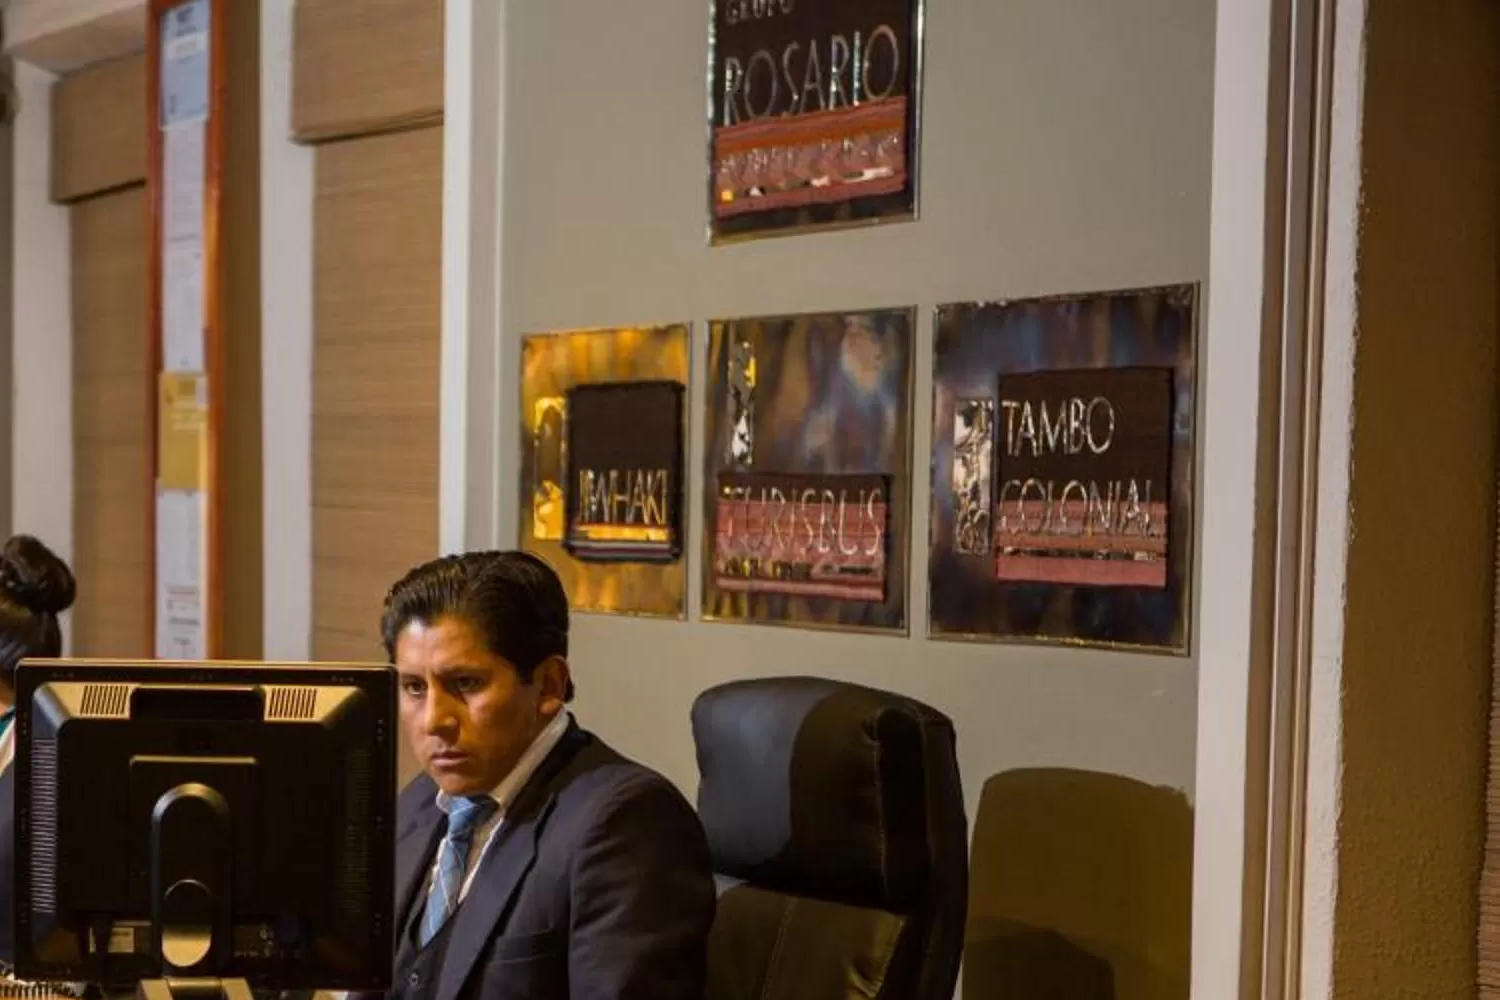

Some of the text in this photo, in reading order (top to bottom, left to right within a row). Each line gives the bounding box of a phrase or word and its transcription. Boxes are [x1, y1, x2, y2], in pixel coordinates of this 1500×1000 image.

[723, 24, 900, 127] ROSARIO
[1001, 396, 1116, 457] TAMBO
[723, 486, 883, 556] TURISBUS
[1000, 477, 1161, 538] COLONIAL
